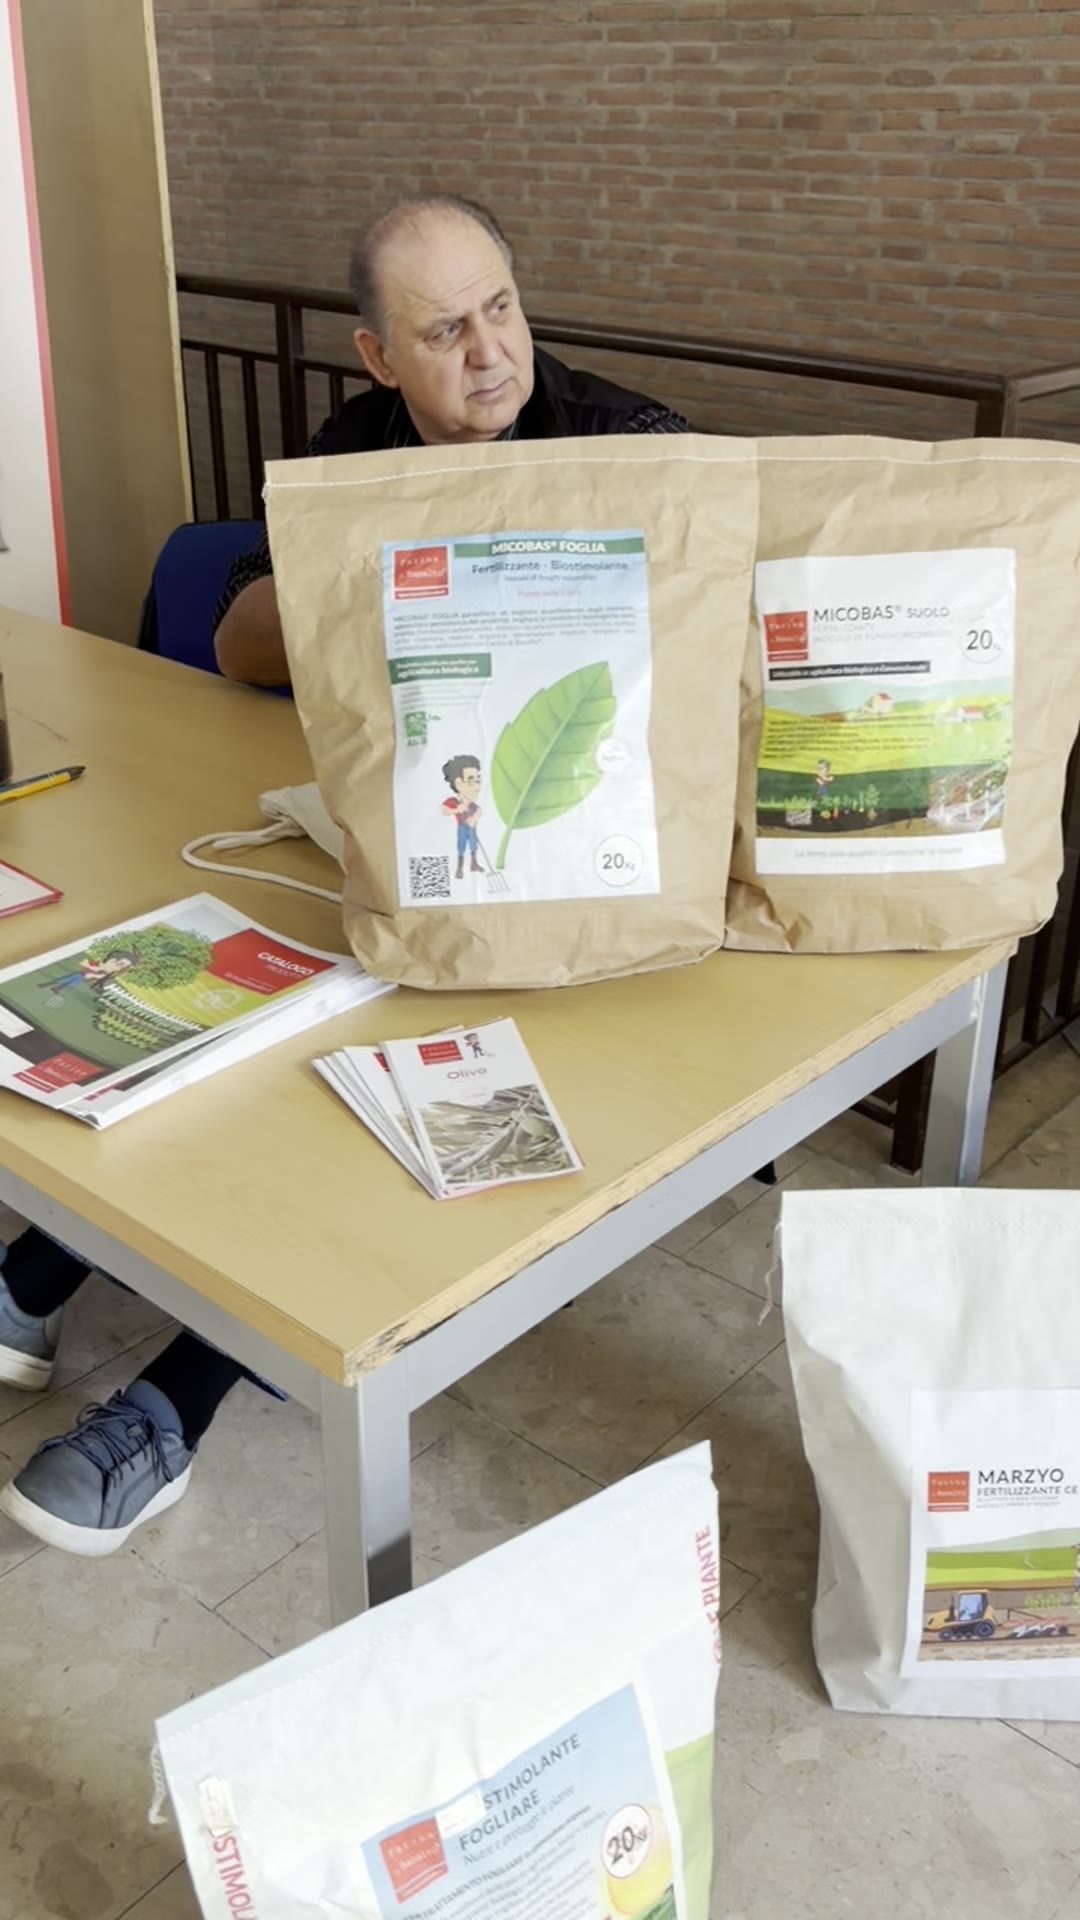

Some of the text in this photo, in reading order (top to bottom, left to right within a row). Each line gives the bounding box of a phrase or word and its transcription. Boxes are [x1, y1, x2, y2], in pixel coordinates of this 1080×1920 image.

[559, 540, 607, 553] FOGLIA
[472, 561, 541, 574] Fertilizzante
[550, 560, 630, 572] Biostimolante
[906, 606, 951, 619] SUOLO
[966, 629, 993, 650] 20
[602, 852, 625, 870] 20
[257, 952, 315, 977] CATALOGO
[446, 1067, 488, 1080] Olivo
[977, 1468, 1065, 1485] MARZYO
[977, 1486, 1061, 1497] FERTILIZZANTE
[695, 1525, 720, 1607] PIANTE
[459, 1788, 540, 1851] FOGLIARE
[606, 1826, 635, 1865] 20
